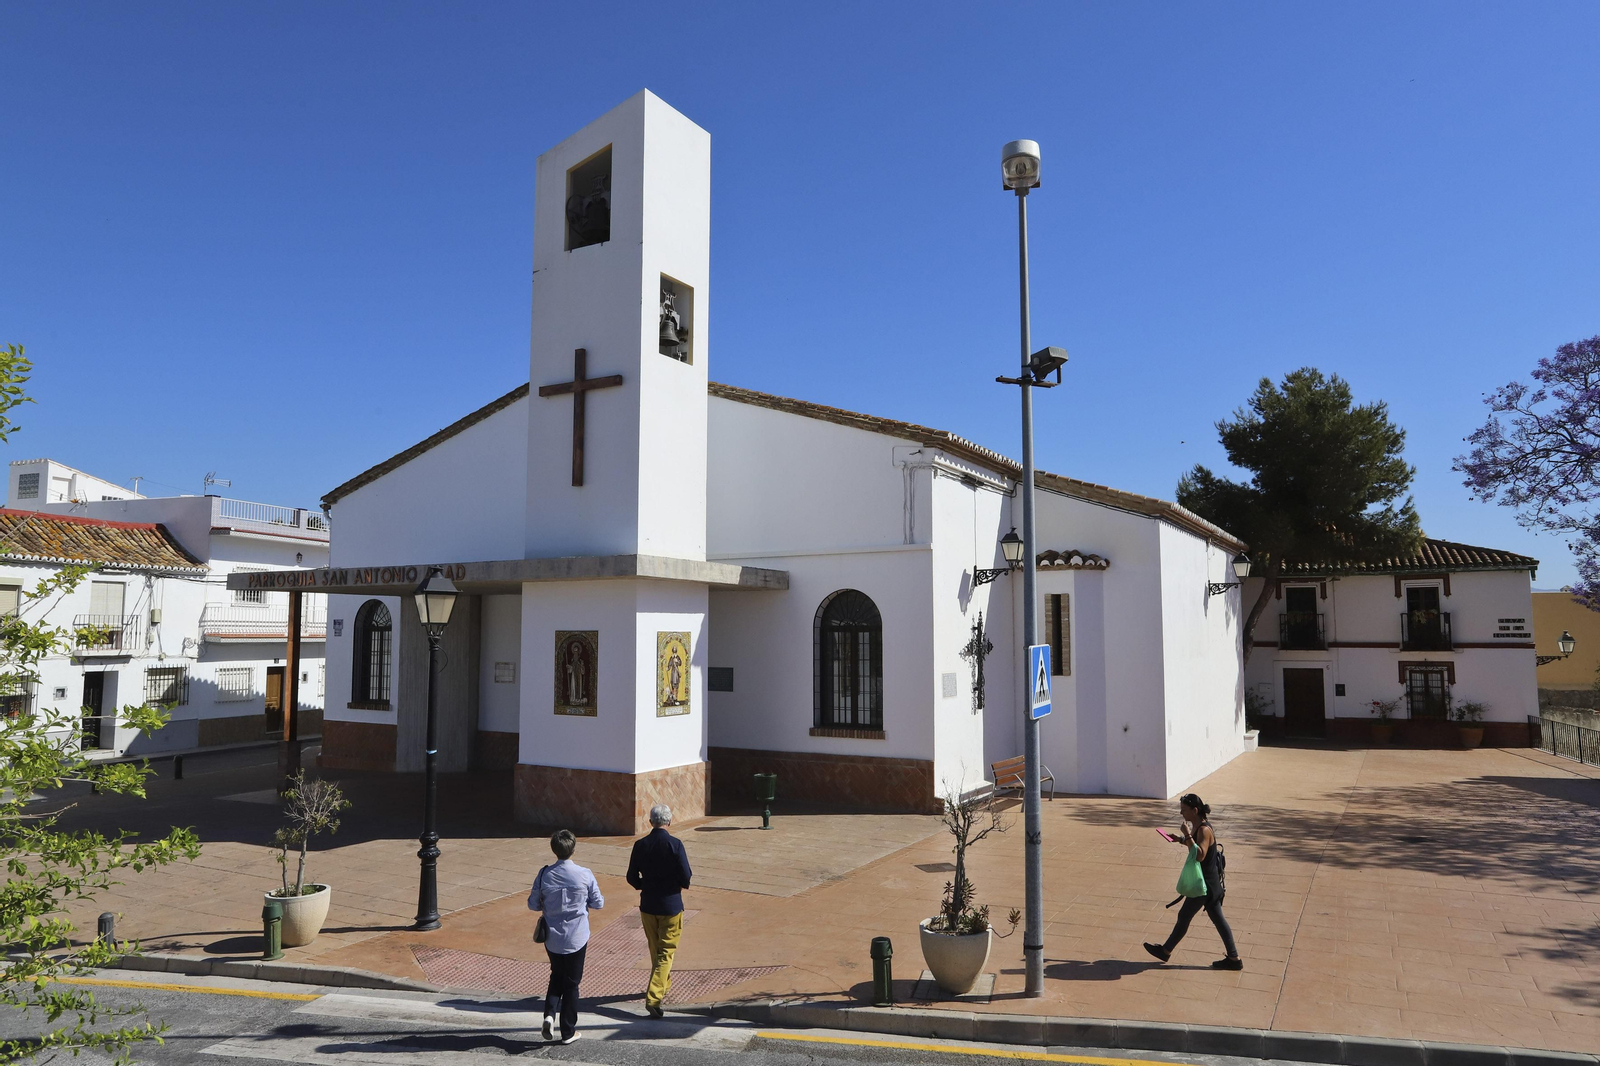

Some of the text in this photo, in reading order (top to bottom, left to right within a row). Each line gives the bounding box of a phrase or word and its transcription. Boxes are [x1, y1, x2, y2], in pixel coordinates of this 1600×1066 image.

[248, 563, 466, 588] PARROQUIA SAN ANTONIO AAD
